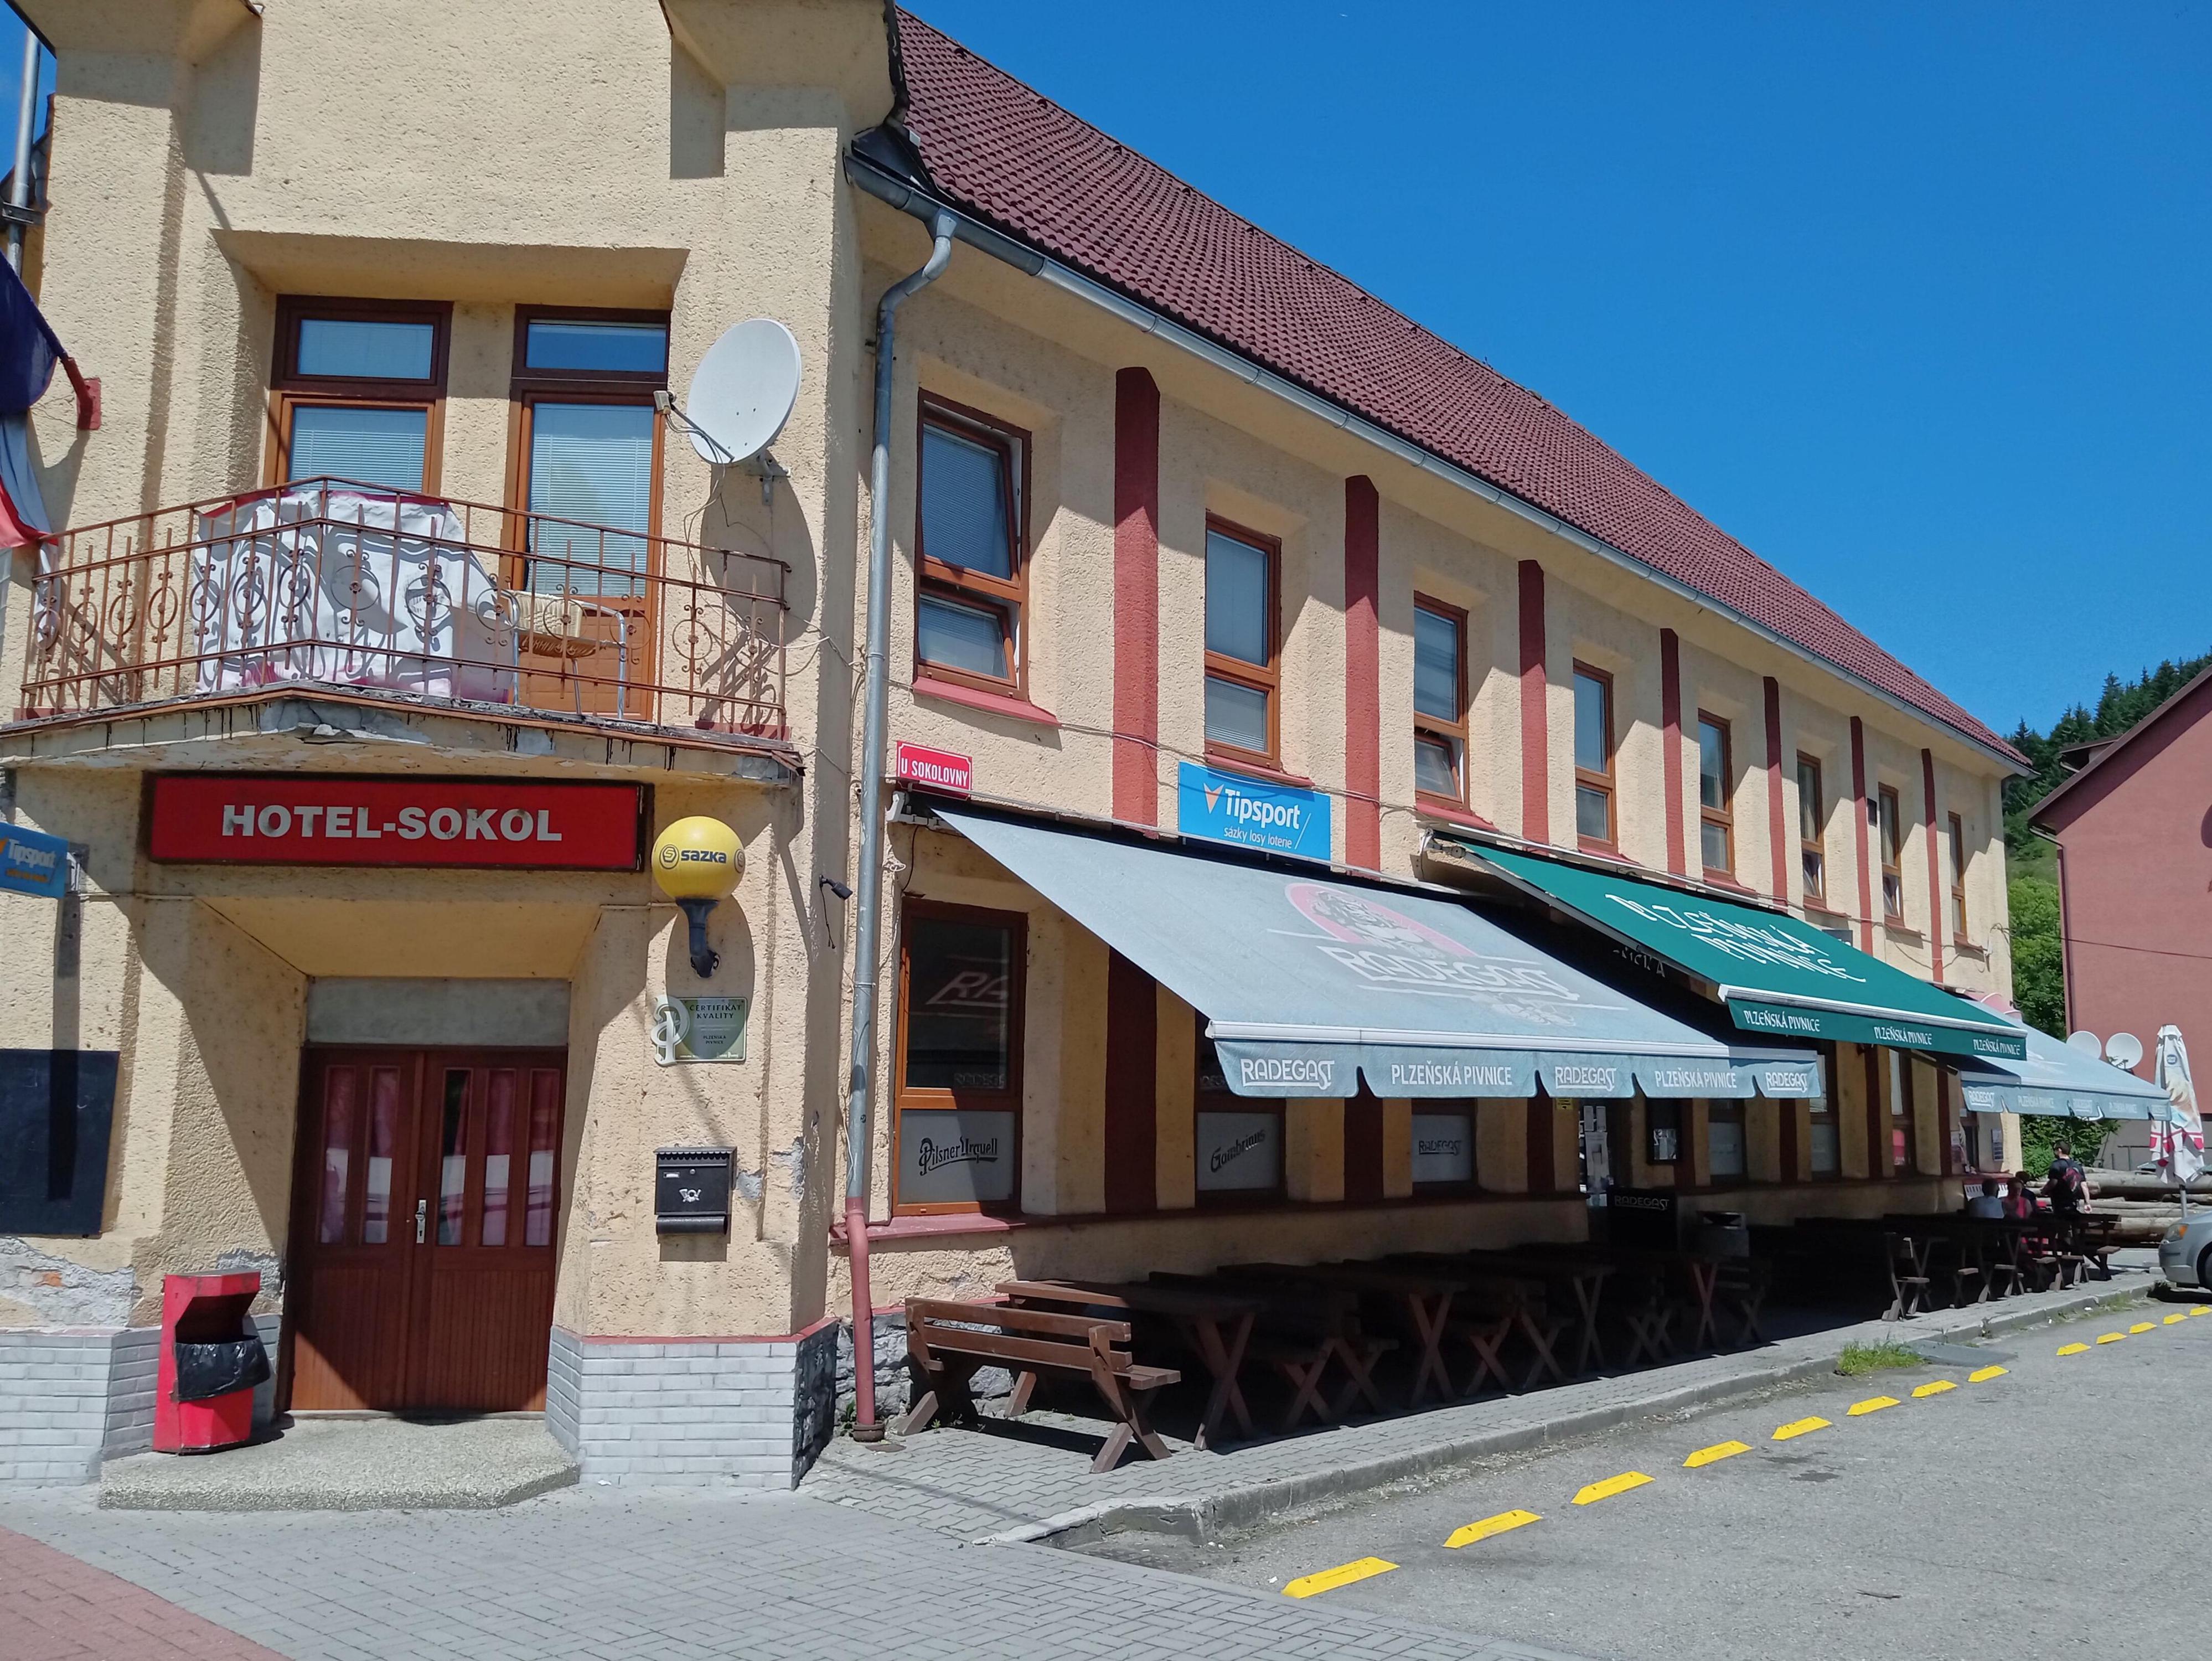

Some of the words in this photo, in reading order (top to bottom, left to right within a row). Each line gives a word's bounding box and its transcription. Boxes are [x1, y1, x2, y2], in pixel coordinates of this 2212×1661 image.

[901, 757, 908, 774] U
[911, 760, 968, 787] SOKOLOVNY
[222, 804, 562, 841] HOTEL-SOKOL
[1224, 788, 1300, 830] Tipsport
[1223, 826, 1248, 843] sázky
[1249, 829, 1266, 847] losy
[1268, 834, 1292, 849] loterie
[8, 838, 56, 869] Tipsport
[1605, 893, 1829, 956] PLZEŇSKÁ
[1691, 933, 1867, 982] PIVNICE
[1316, 945, 1580, 1000] RADEGAST
[1743, 1010, 1789, 1028] PLZEŇSKÁ
[1788, 1015, 1821, 1032] PIVNICE
[1907, 1031, 1932, 1045] PIVNICE
[1999, 1042, 2020, 1055] PIVNICE
[1240, 1058, 1335, 1090] RADEGAST
[1391, 1060, 1462, 1085] PLZEŇSKÁ
[1464, 1065, 1513, 1086] PIVNICE
[1554, 1066, 1617, 1092] RADEGAST
[1655, 1067, 1704, 1088] PLZEŇSKÁ
[1703, 1072, 1737, 1089] PIVNICE
[1765, 1072, 1808, 1093] RADEGAST
[918, 1137, 962, 1176] Pilsner
[959, 1136, 998, 1163] Urquell
[1211, 1129, 1266, 1173] Gambrinus
[1418, 1139, 1462, 1156] RADEGAST
[1614, 1195, 1670, 1211] RADEGAST
